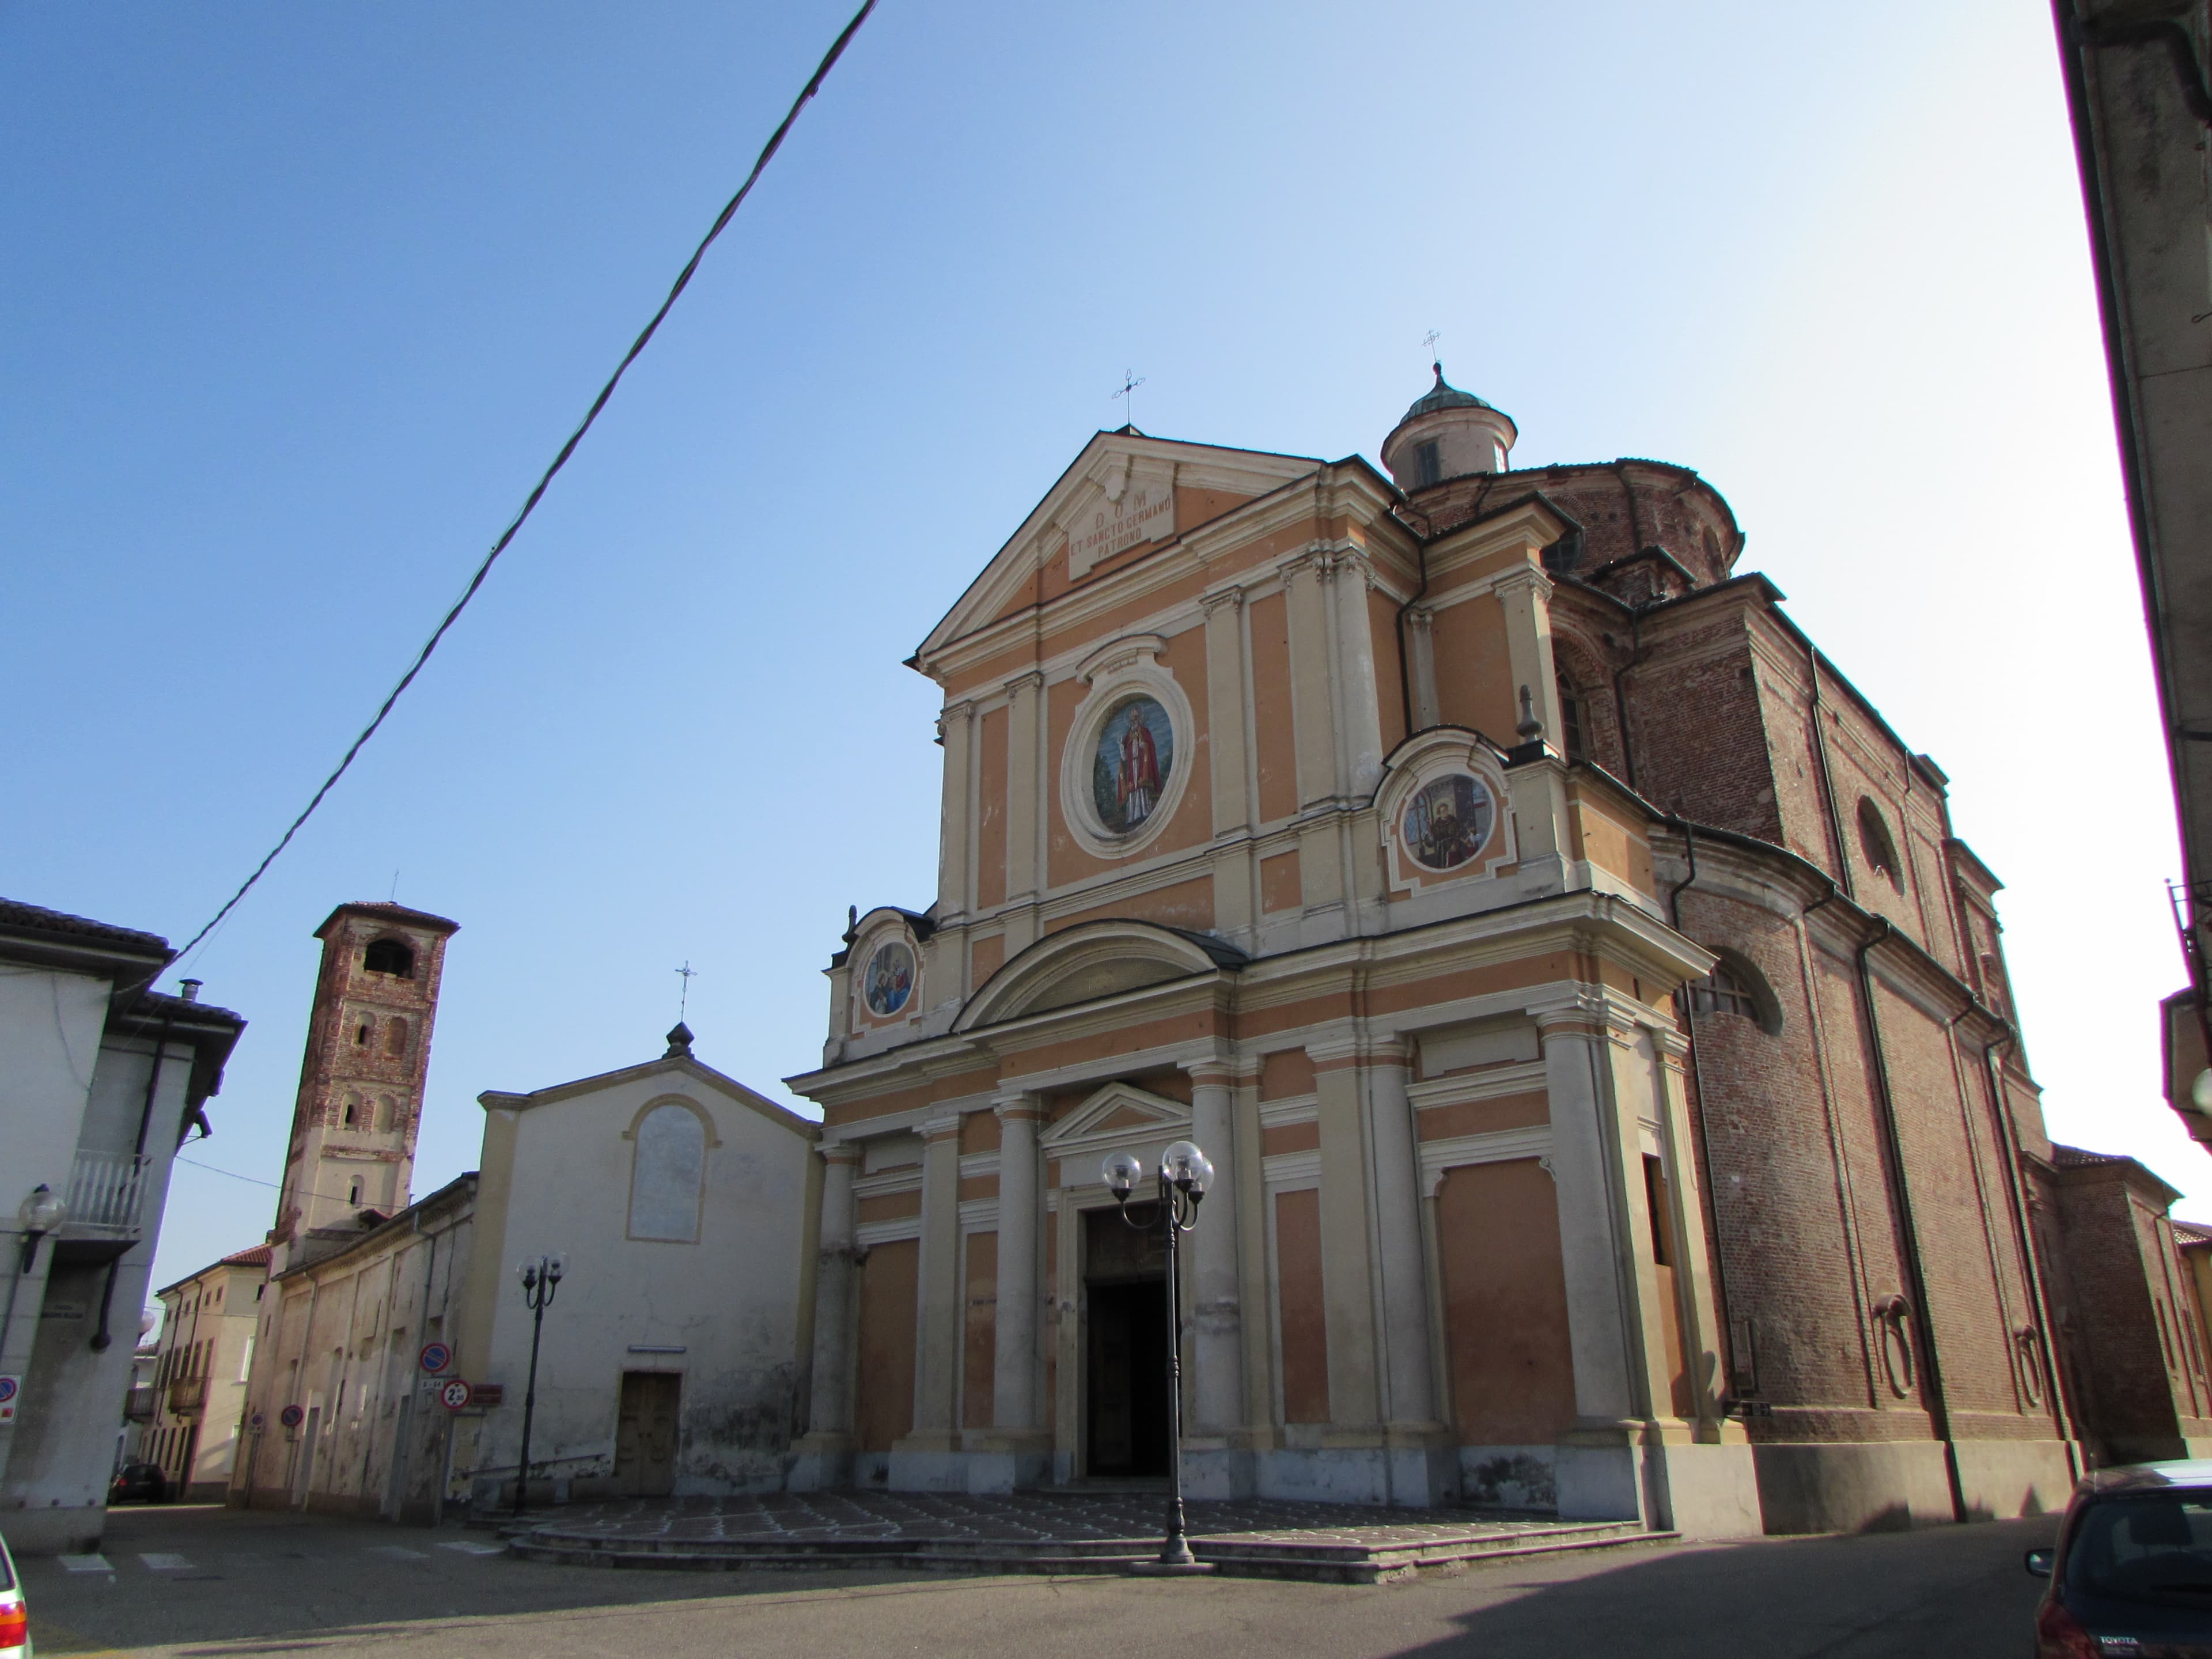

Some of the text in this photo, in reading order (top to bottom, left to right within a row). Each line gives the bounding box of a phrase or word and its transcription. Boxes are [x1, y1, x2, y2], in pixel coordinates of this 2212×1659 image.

[1115, 503, 1123, 519] O
[1134, 491, 1146, 509] M
[1070, 497, 1171, 556] ET SANCTO GERMANO
[1098, 528, 1142, 558] PATRONO
[2100, 1636, 2139, 1645] TOYOTA
